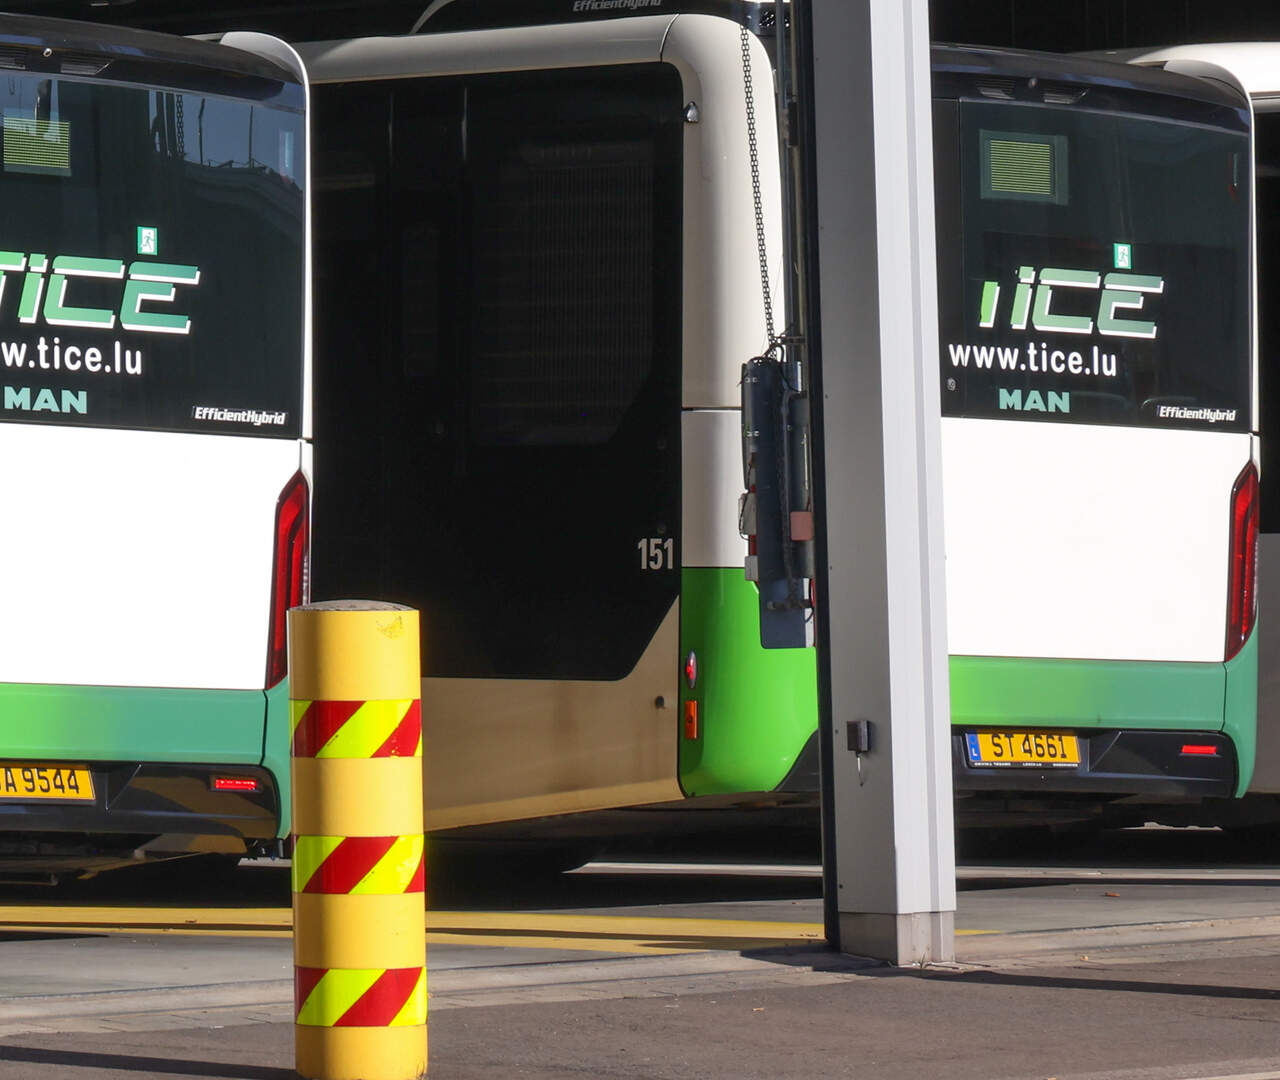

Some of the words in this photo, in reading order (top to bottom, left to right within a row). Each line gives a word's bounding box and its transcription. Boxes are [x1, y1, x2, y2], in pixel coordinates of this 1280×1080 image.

[948, 341, 1117, 377] www.tice.lu
[3, 385, 88, 415] MAN
[998, 388, 1071, 414] MAN
[1158, 405, 1237, 423] EfficientHybrid
[194, 406, 286, 426] EfficientHybrid
[637, 538, 674, 570] 151
[991, 732, 1015, 758] ST
[1021, 732, 1068, 759] 4661
[21, 766, 80, 795] 9544
